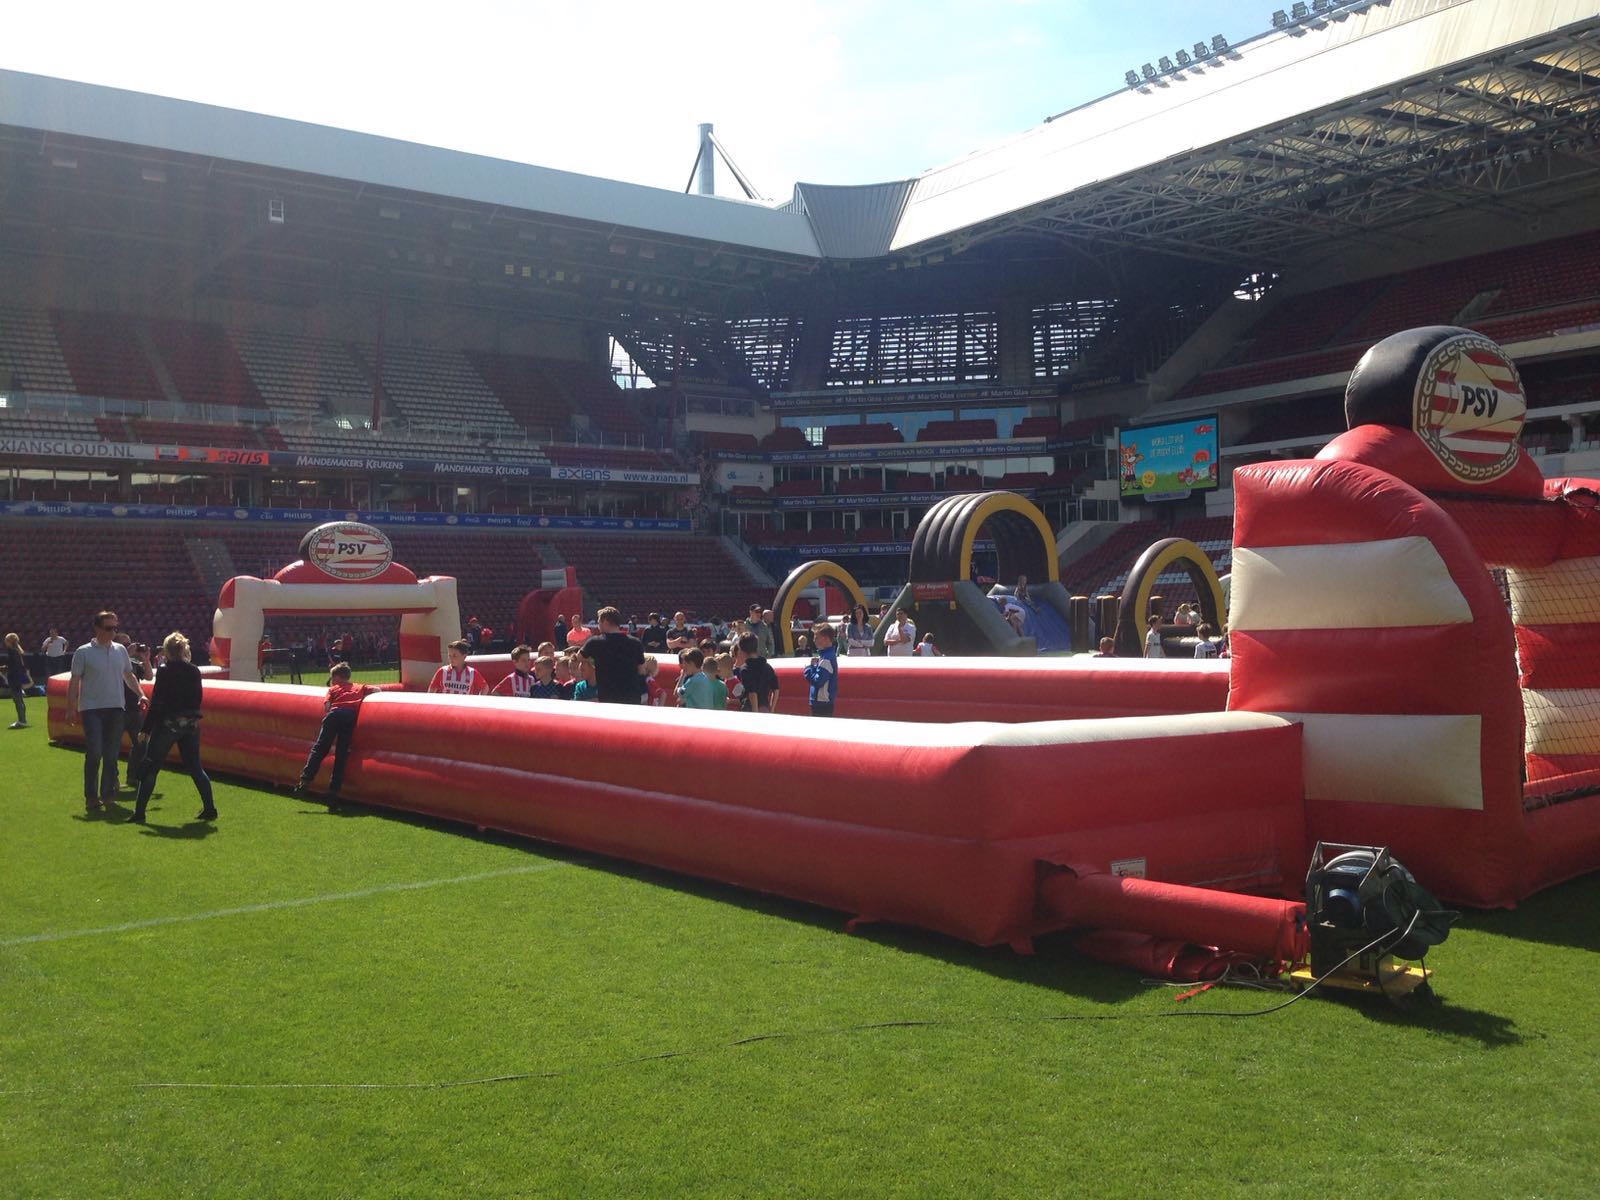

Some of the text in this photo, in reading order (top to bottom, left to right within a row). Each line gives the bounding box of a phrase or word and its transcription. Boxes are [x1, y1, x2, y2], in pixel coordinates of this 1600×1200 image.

[1460, 385, 1498, 418] PSV
[986, 445, 1006, 453] Martin
[558, 468, 611, 480] axians
[624, 473, 689, 482] www.axians.nl
[783, 498, 802, 506] Martin
[847, 497, 865, 505] Martin
[866, 496, 879, 504] Glas
[911, 494, 930, 502] Martin
[37, 505, 72, 514] PHILIPS
[166, 508, 197, 517] PHILIPS
[283, 511, 312, 520] PHILIPS
[389, 514, 416, 523] PHILIPS
[487, 516, 512, 525] PHILIPS
[337, 542, 367, 555] PSV
[799, 546, 821, 554] Martin
[822, 546, 837, 554] Glas
[872, 545, 894, 553] Martin
[444, 682, 470, 690] PHILIPS
